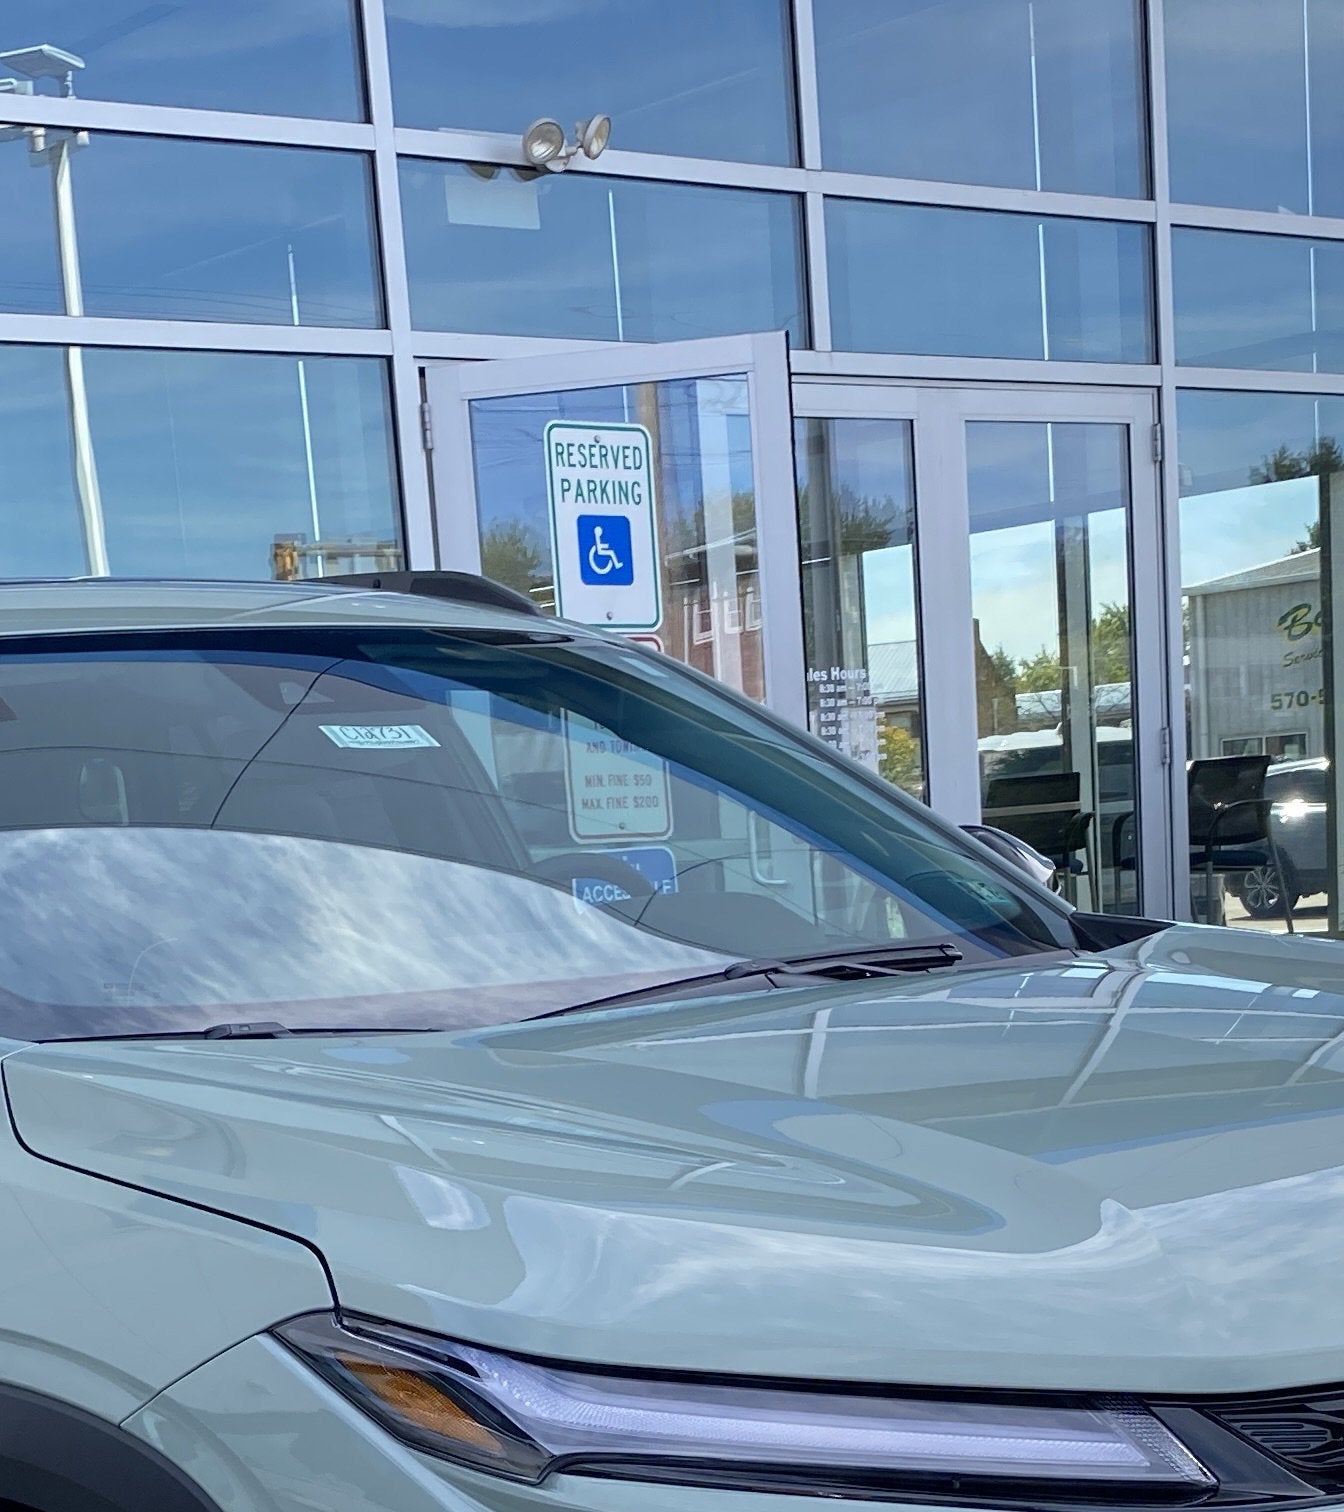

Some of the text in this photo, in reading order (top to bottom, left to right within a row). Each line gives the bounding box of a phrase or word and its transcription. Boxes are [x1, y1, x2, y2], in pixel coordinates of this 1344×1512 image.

[554, 442, 643, 471] RESERVED
[560, 478, 642, 505] PARKING
[830, 666, 867, 681] Hours
[586, 740, 607, 753] AND
[607, 773, 630, 788] FINE
[632, 773, 653, 787] $50
[606, 796, 630, 810] FINE
[632, 795, 660, 809] $200
